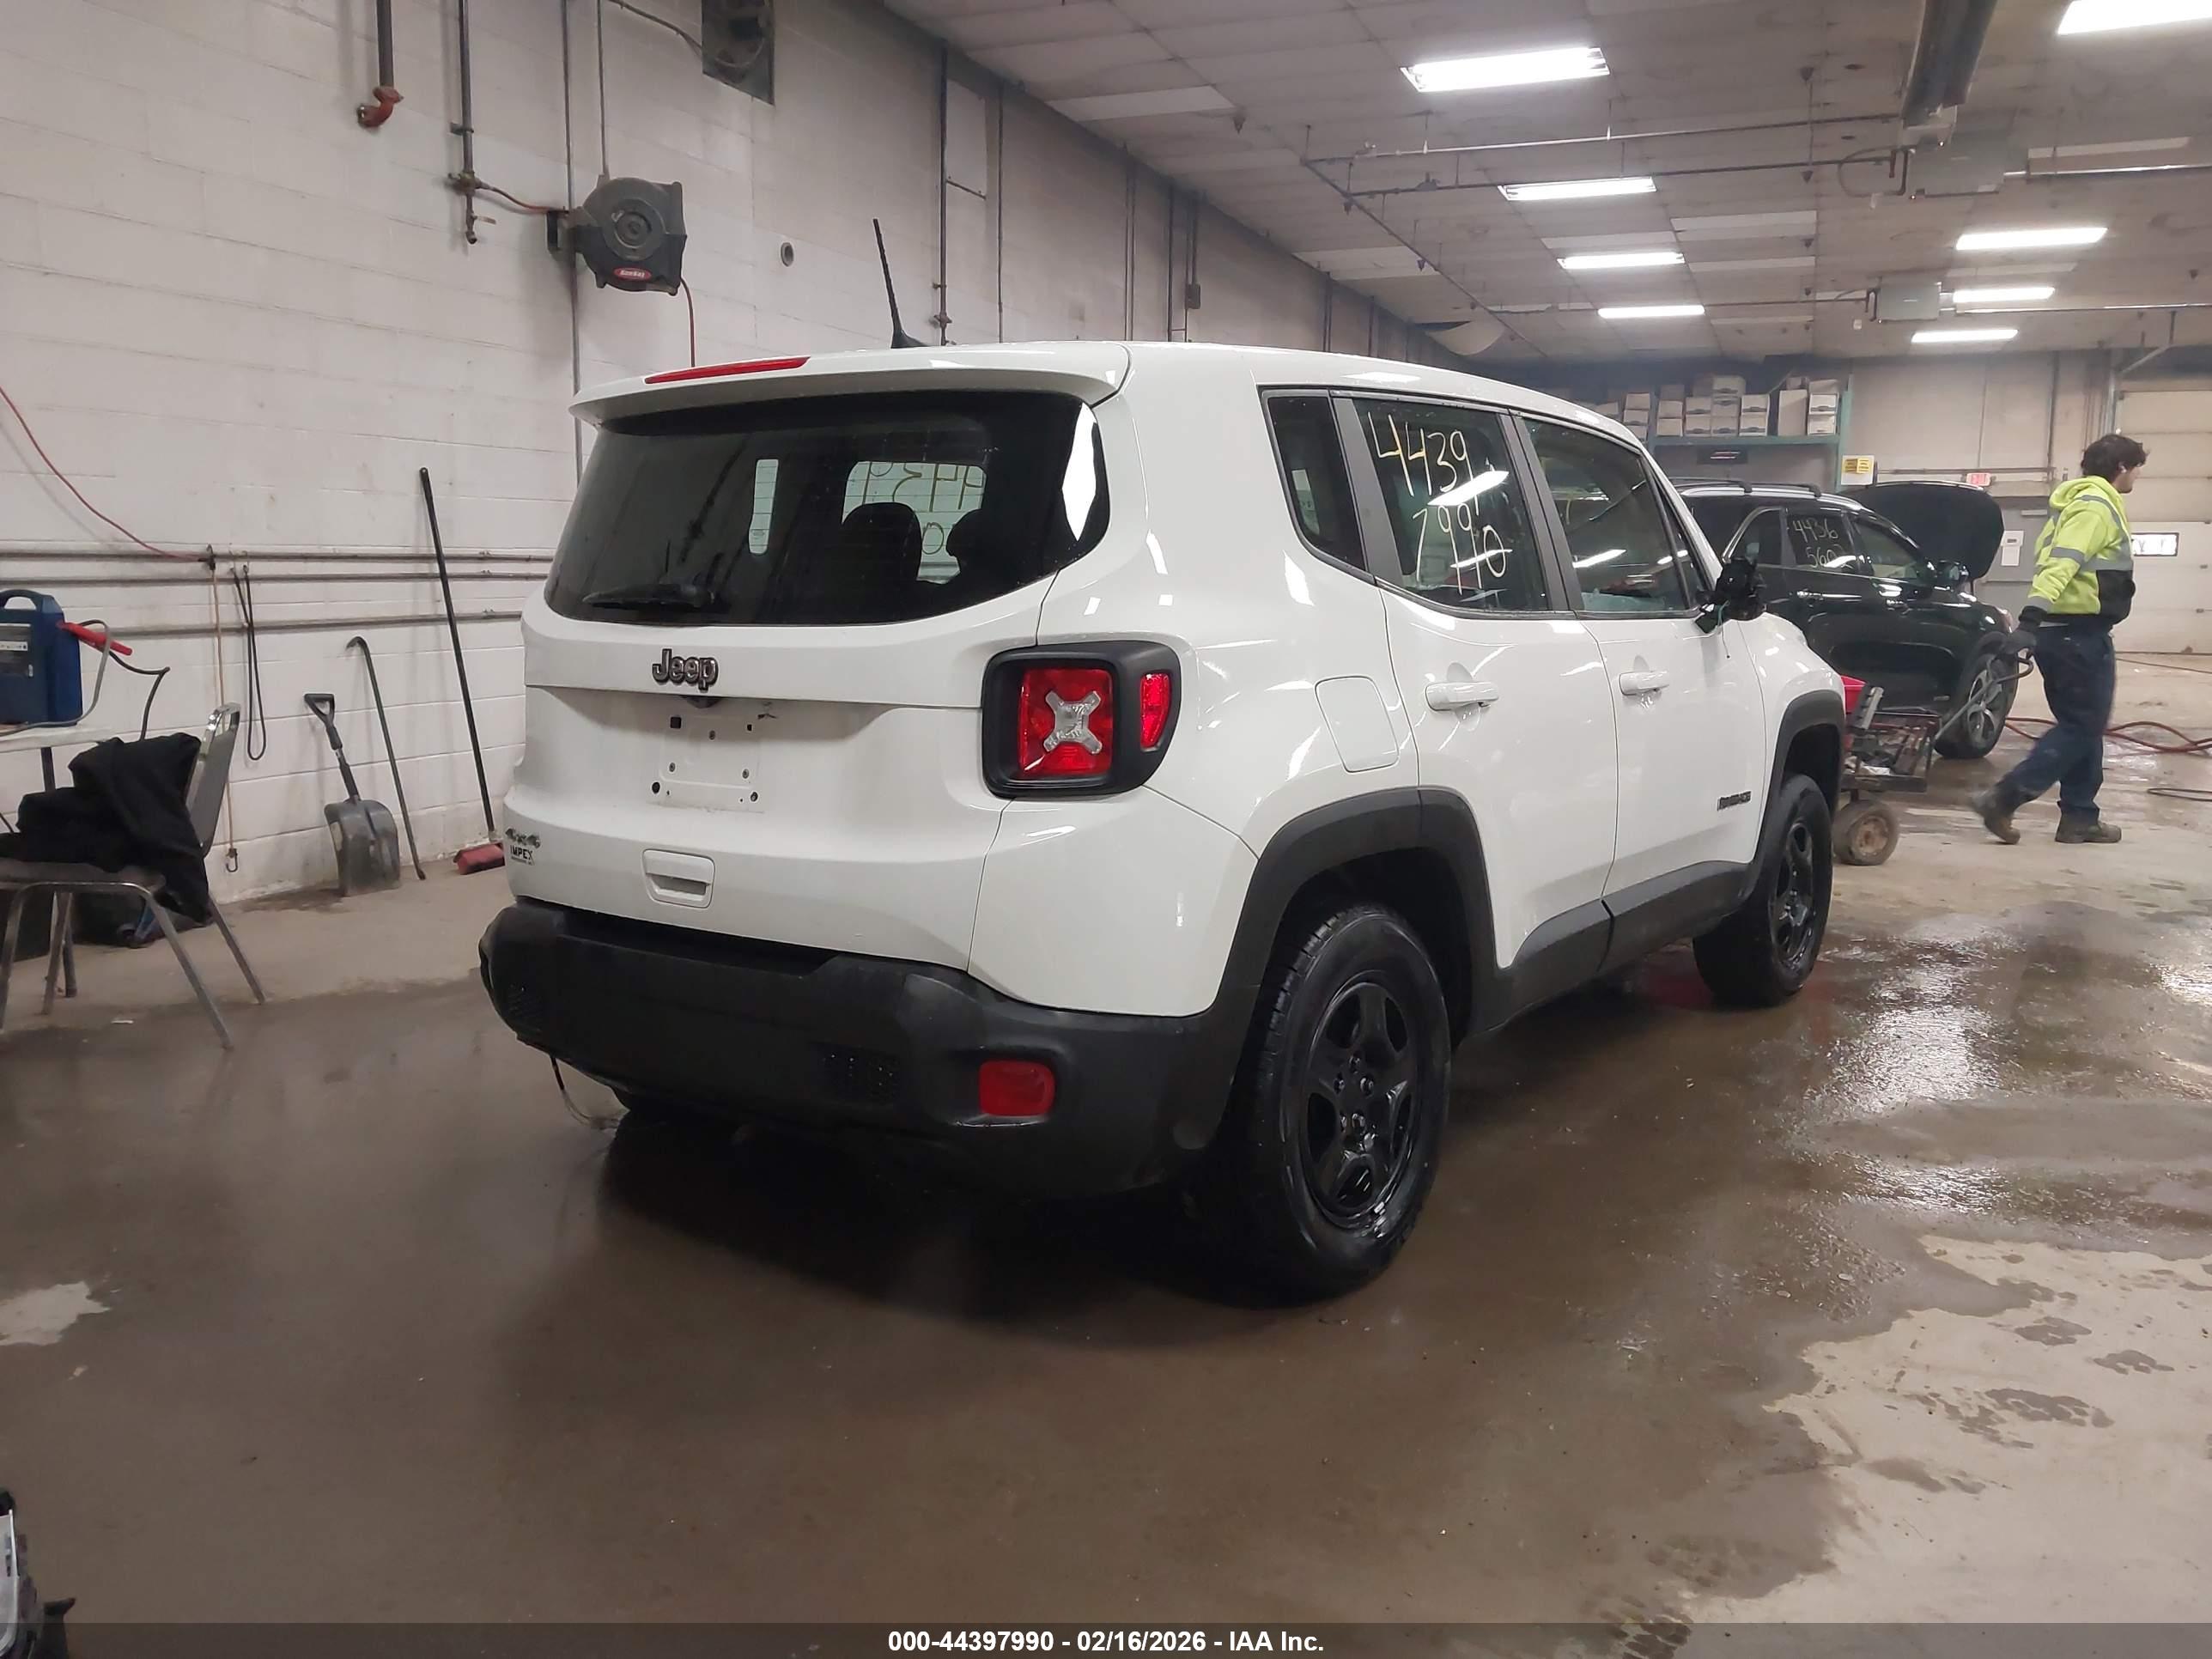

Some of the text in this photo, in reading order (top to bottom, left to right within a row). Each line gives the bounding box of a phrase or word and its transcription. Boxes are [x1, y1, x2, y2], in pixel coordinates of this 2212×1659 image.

[1367, 411, 1480, 516] 4439
[1412, 502, 1507, 596] 7990
[1792, 517, 1838, 543] 4436
[652, 648, 719, 690] Jeep
[510, 844, 534, 863] IMPEX
